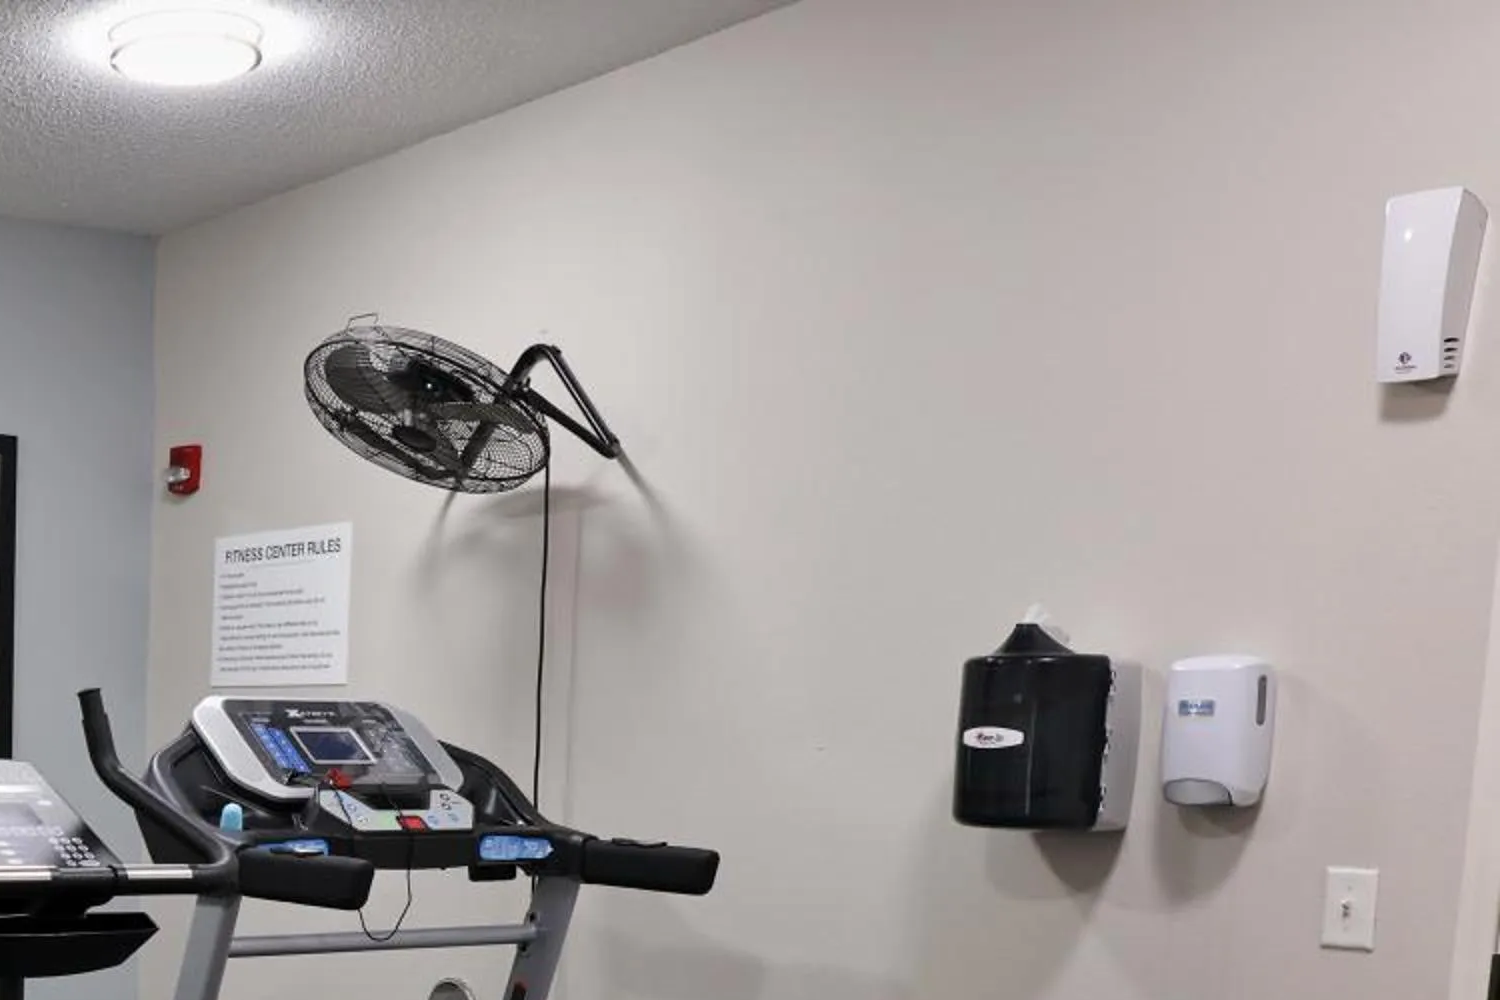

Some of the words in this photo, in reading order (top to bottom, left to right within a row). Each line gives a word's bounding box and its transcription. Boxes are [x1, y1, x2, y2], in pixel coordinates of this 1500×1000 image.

[225, 548, 263, 563] FITNESS
[265, 542, 305, 560] CENTER
[307, 538, 341, 555] RULES
